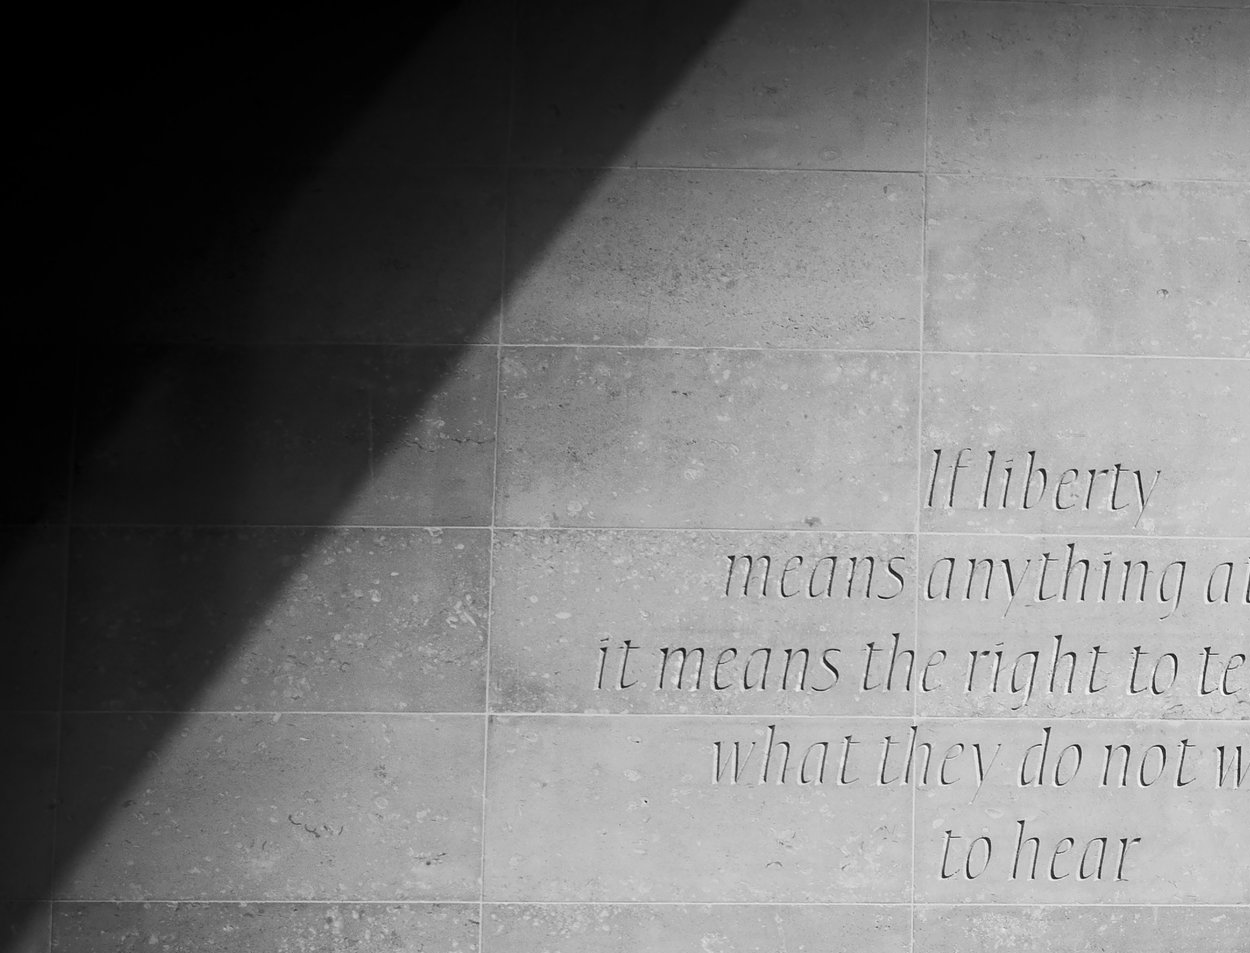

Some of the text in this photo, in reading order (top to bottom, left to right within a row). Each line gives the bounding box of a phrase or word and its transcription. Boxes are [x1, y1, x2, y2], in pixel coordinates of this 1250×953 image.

[923, 448, 1161, 529] If liberty
[722, 554, 907, 600] means
[924, 543, 1187, 620] anything
[594, 637, 640, 691] it
[656, 645, 841, 692] means
[860, 633, 948, 693] the
[963, 634, 1107, 710] right
[1127, 645, 1179, 695] to
[711, 725, 860, 785] what
[877, 725, 1002, 804] they
[1018, 727, 1083, 787] do
[1100, 738, 1200, 789] not
[939, 820, 1142, 882] to hear
